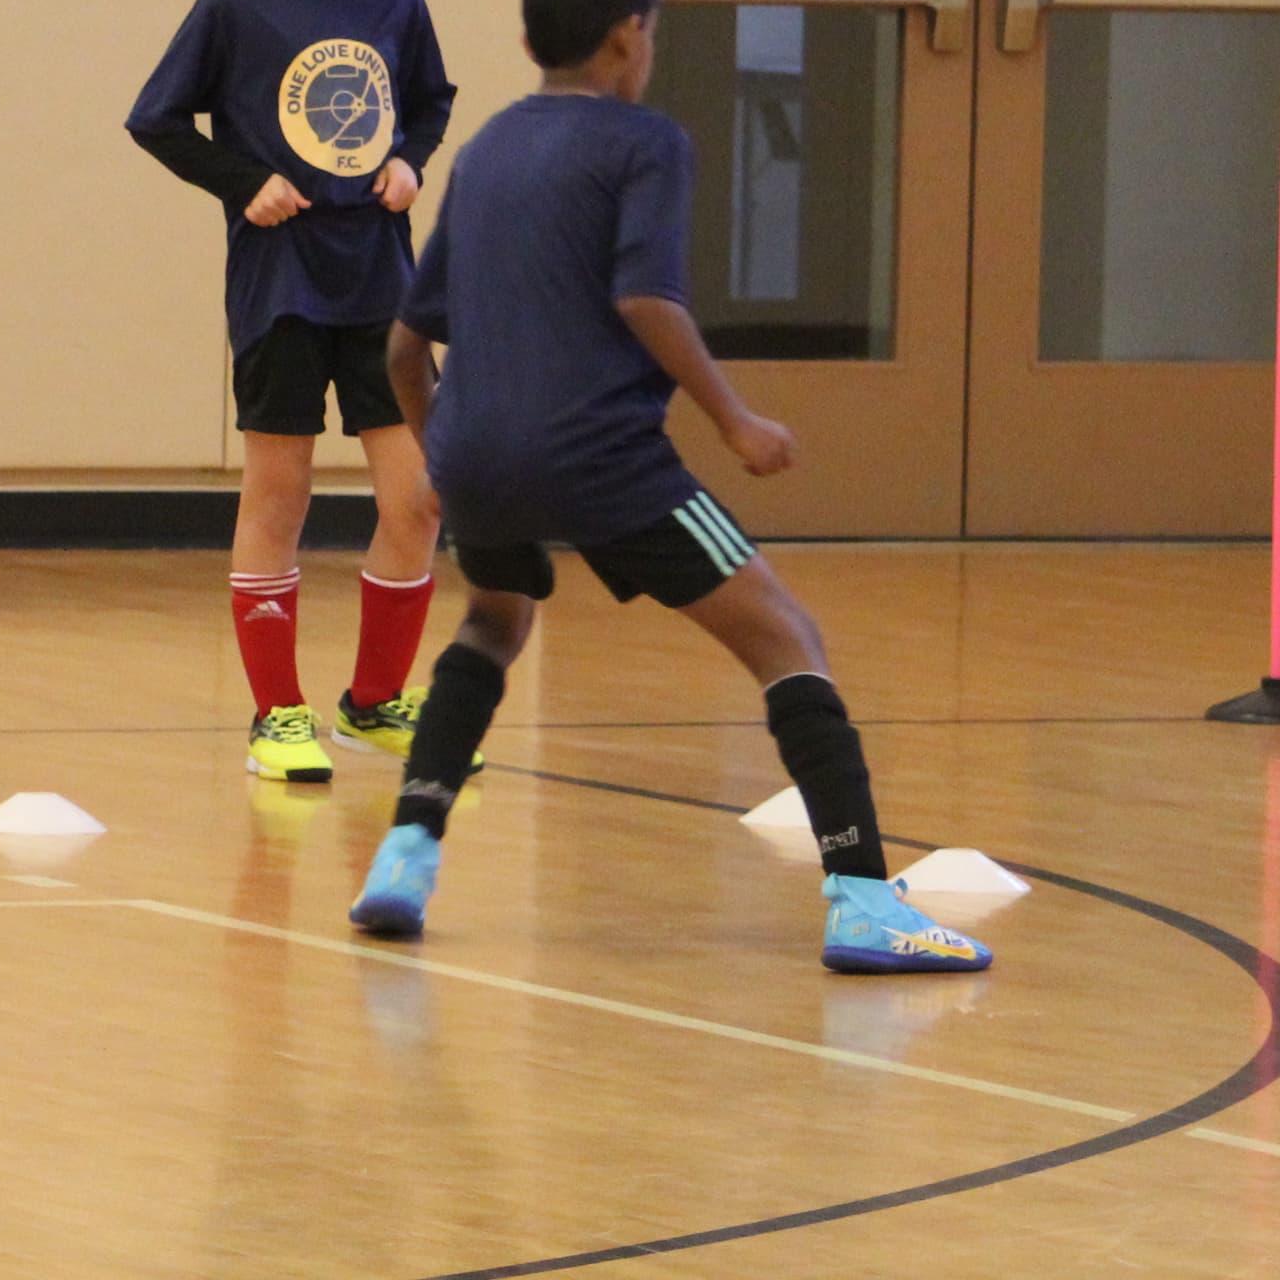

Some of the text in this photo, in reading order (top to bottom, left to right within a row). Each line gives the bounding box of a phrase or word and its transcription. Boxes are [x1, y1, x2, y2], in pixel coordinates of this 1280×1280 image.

[287, 44, 392, 115] ONE LOVE UNITED
[336, 156, 362, 169] F.C.
